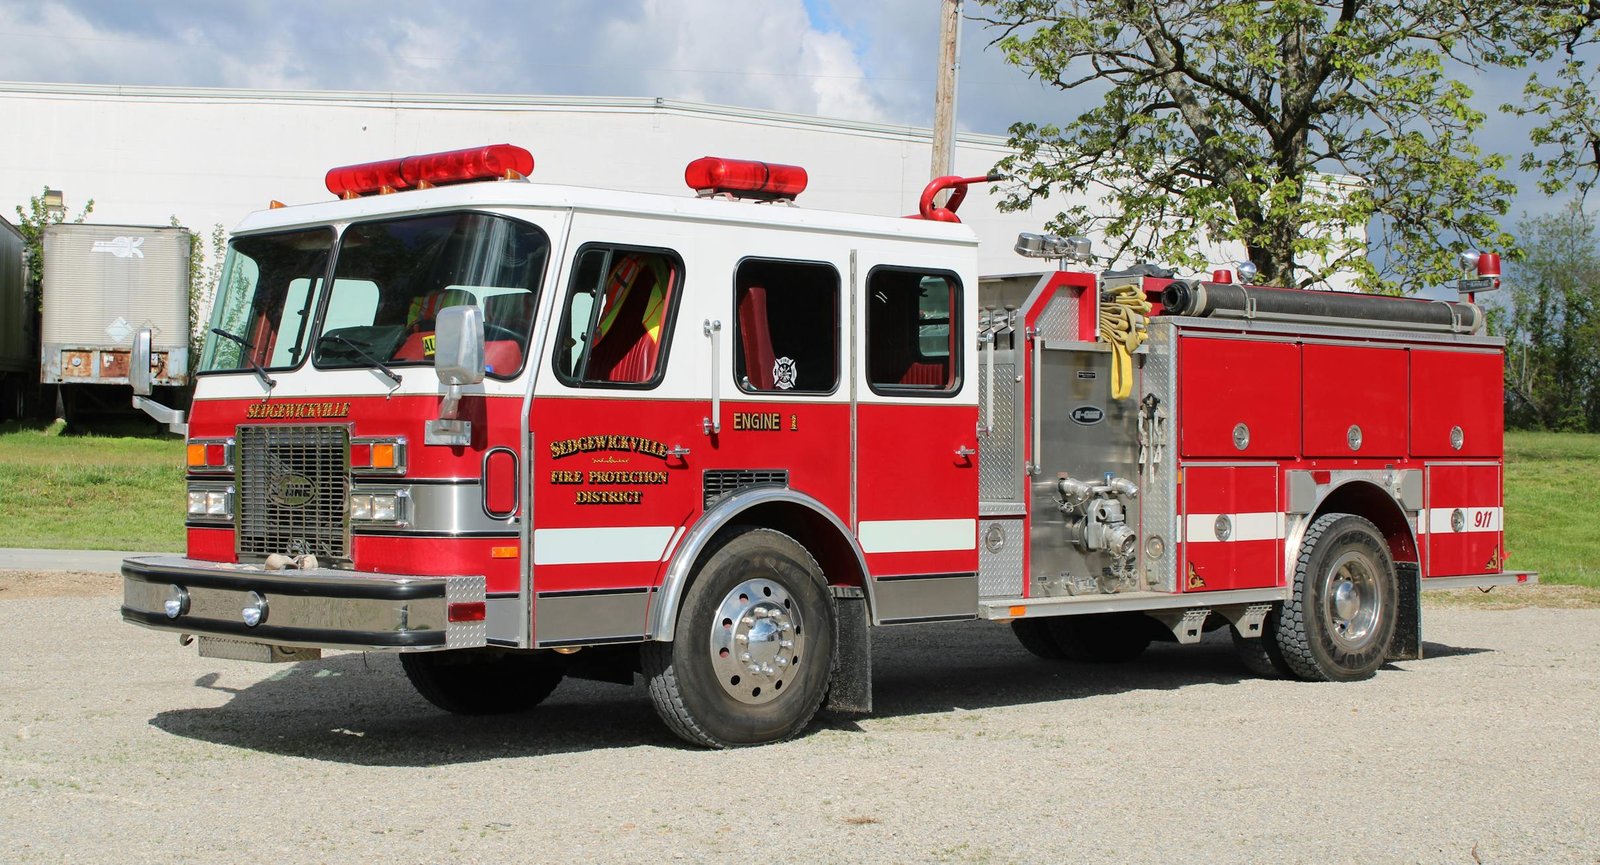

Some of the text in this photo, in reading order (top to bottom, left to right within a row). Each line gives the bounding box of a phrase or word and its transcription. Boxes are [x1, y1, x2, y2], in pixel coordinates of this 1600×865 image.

[247, 402, 350, 419] SEDGEWICKVILLE
[733, 412, 798, 431] ENGINE 1
[550, 435, 668, 460] SEDGEWICKVILLE
[551, 471, 668, 484] FIRE PROTECTION
[576, 491, 643, 504] DISTRICT
[1474, 511, 1492, 528] 911
